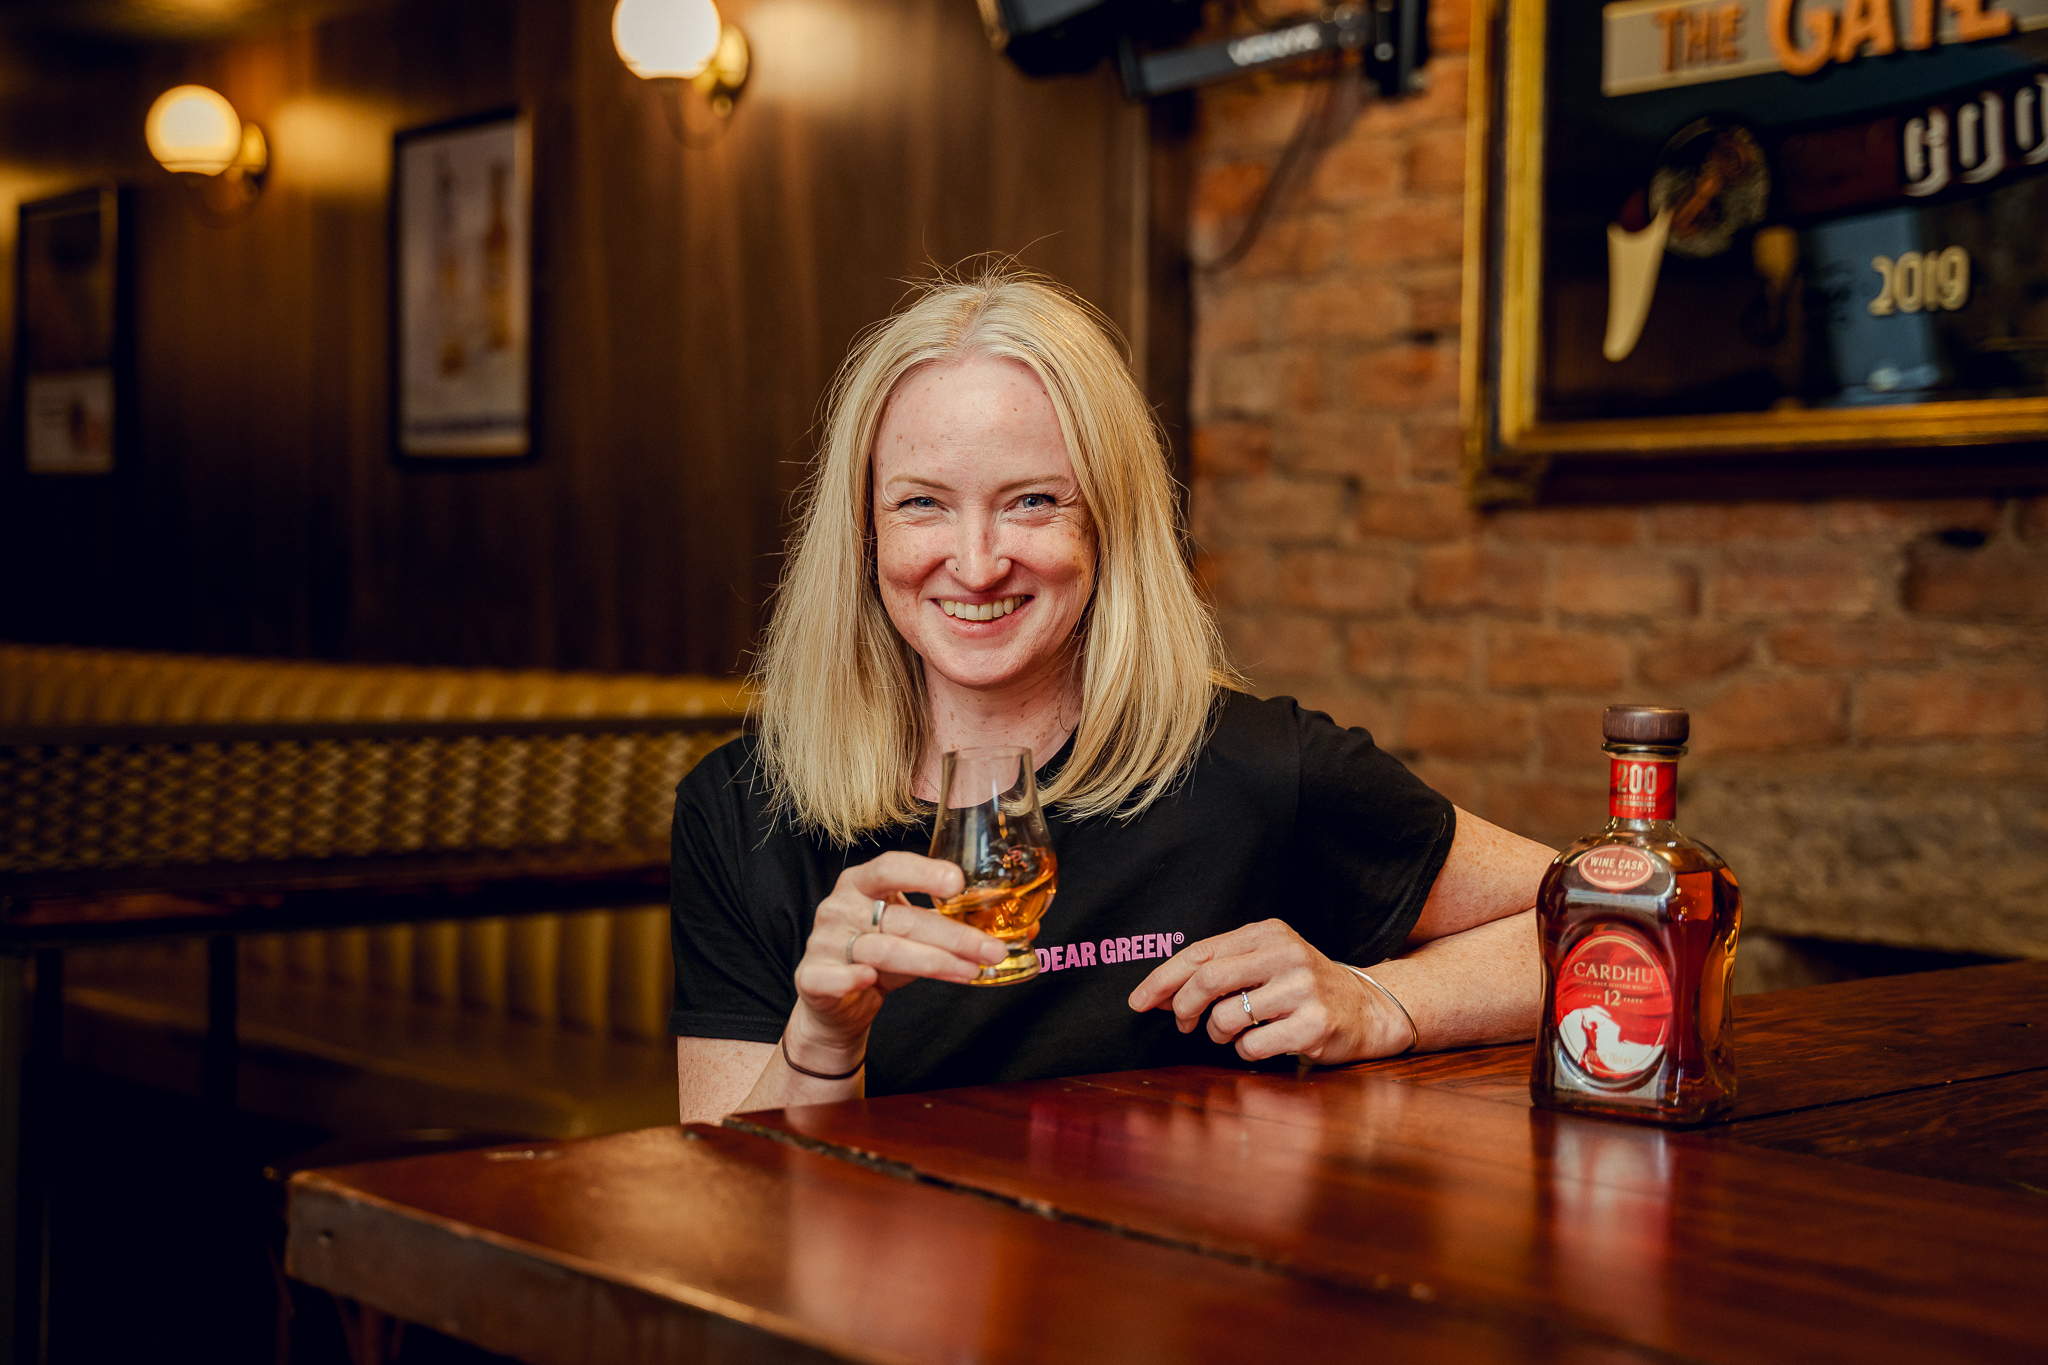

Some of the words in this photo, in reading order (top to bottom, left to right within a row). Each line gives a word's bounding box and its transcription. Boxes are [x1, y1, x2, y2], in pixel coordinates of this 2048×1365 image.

[1653, 7, 1744, 73] THE
[1767, 0, 2017, 76] GATE
[1869, 246, 1970, 315] 2019
[1617, 764, 1657, 794] 200
[1591, 857, 1615, 868] WINE
[1618, 859, 1644, 871] CASK
[1035, 942, 1096, 973] DEAR
[1574, 961, 1653, 983] CARDHU
[1604, 989, 1620, 1006] 12
